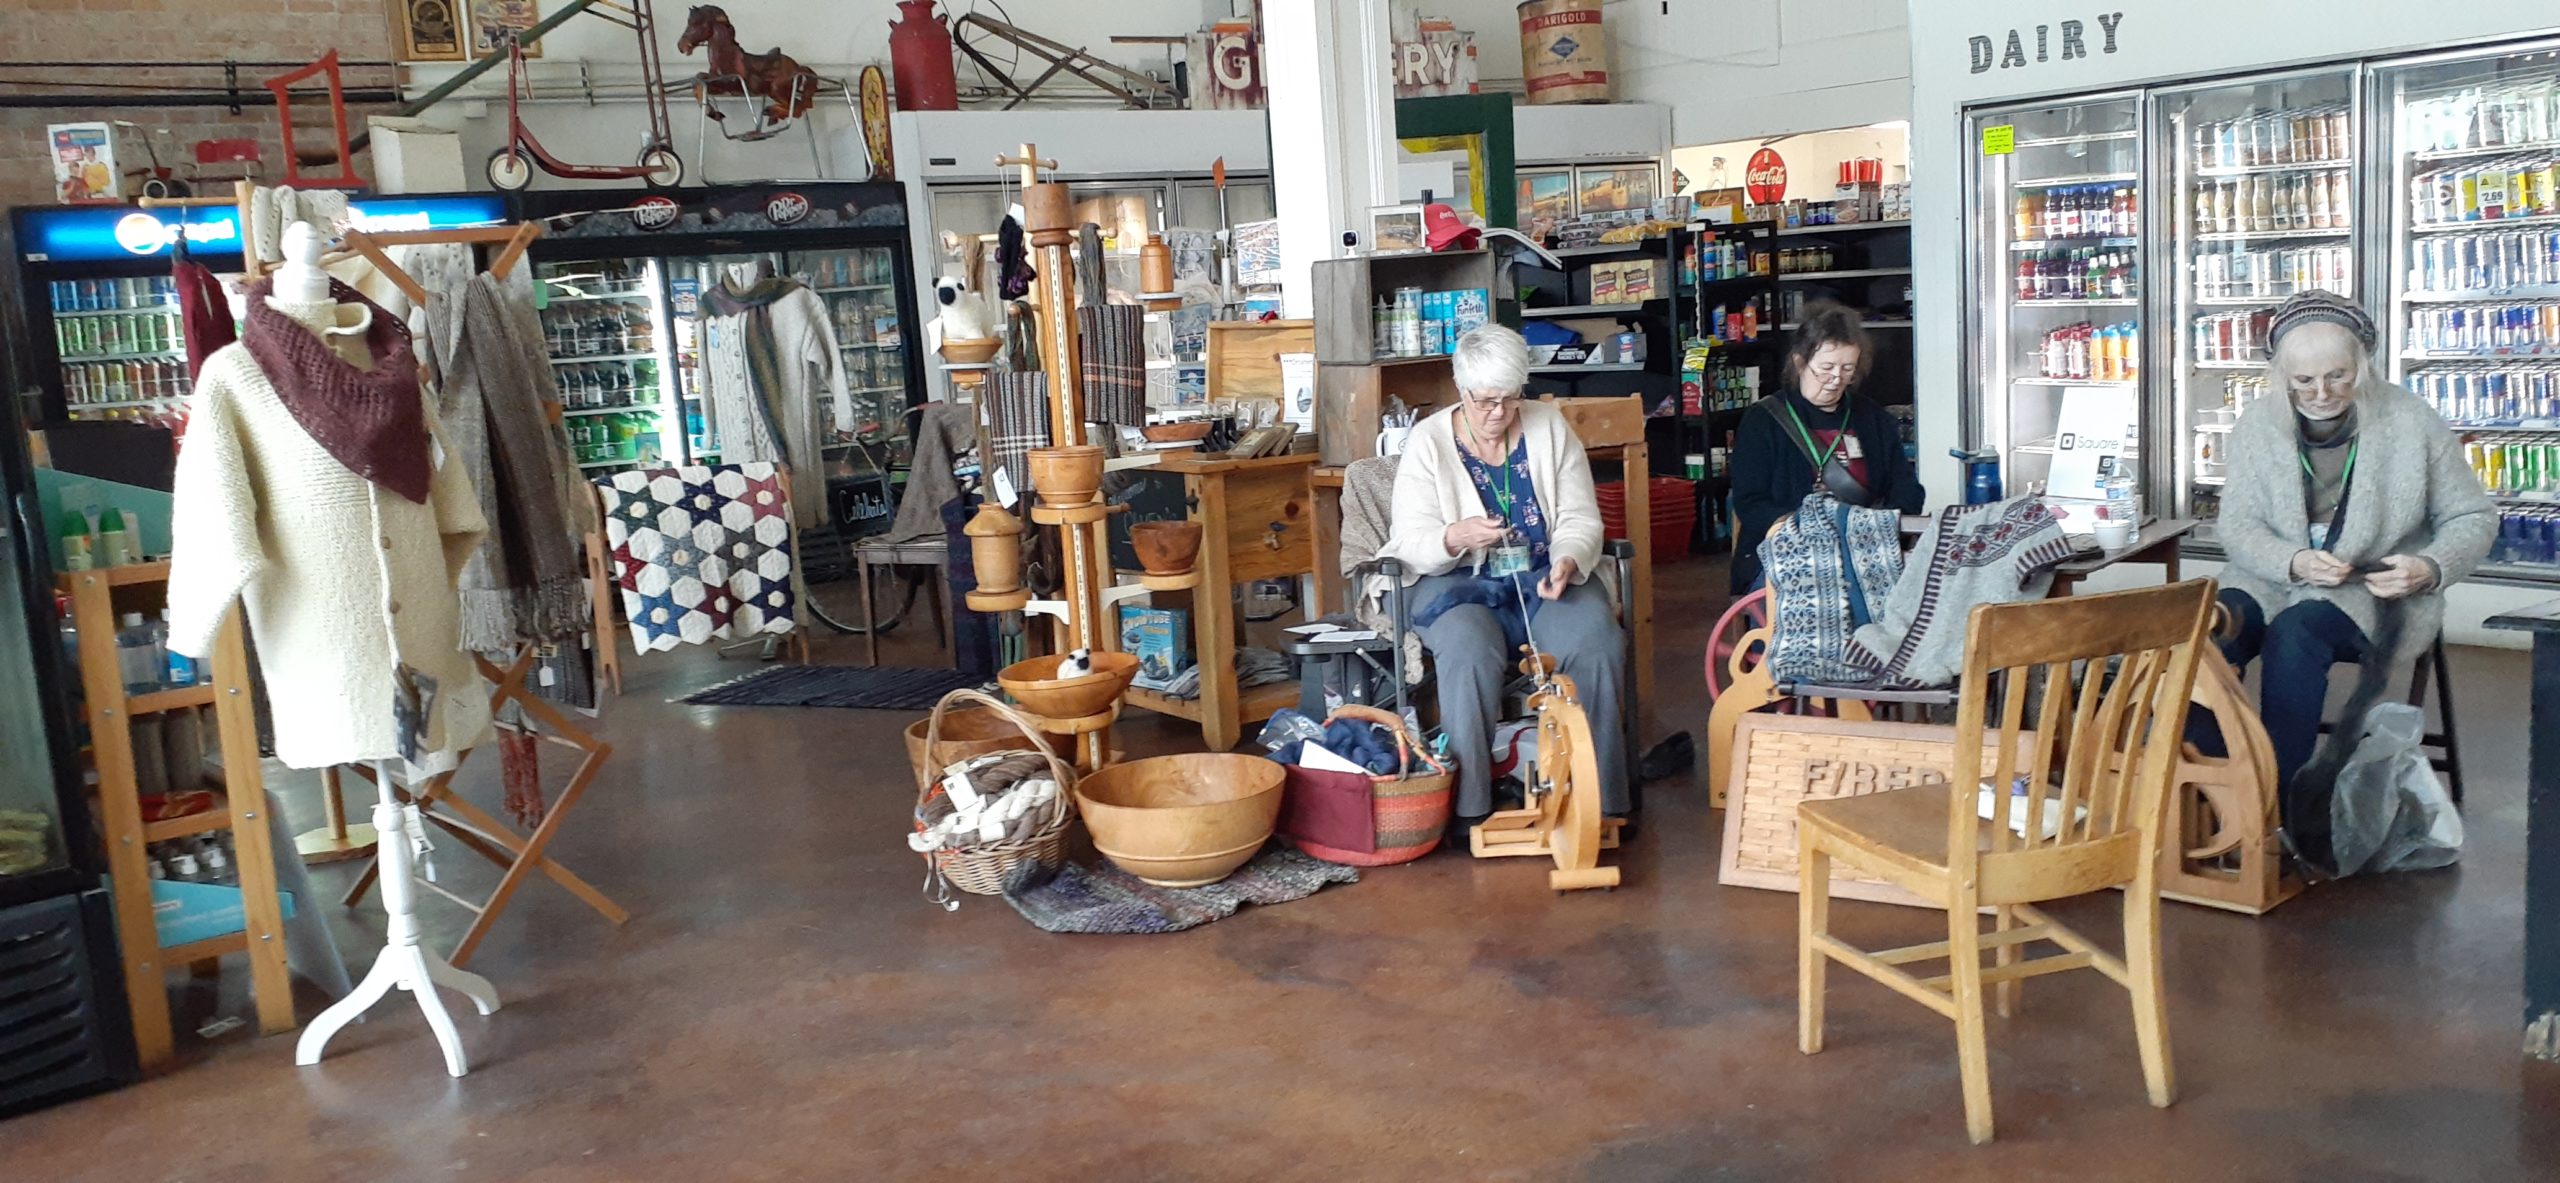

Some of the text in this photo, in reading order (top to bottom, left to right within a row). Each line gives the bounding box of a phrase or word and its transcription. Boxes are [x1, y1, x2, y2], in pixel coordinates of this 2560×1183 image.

[1537, 12, 1587, 27] DARIGOLD
[1968, 12, 2123, 74] DAIRY
[1748, 166, 1785, 186] Coca-Cola
[772, 201, 803, 220] Pepper
[1457, 302, 1484, 315] Funfetti
[2078, 435, 2119, 449] Square
